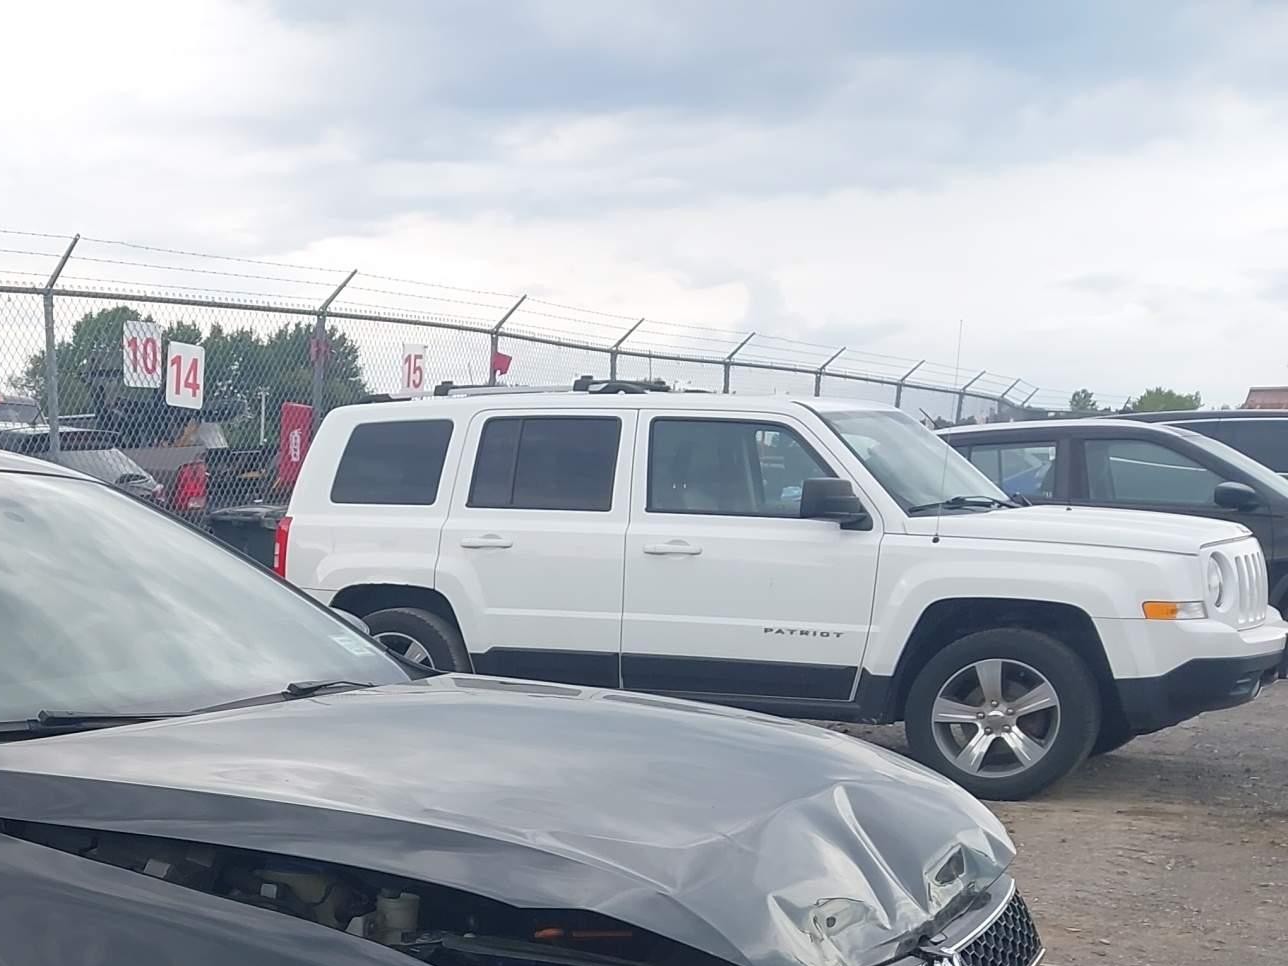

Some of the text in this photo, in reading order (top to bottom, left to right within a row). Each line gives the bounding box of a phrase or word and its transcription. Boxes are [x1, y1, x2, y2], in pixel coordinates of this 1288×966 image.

[127, 336, 158, 375] 10
[404, 354, 424, 389] 15
[170, 354, 201, 398] 14
[763, 627, 845, 638] PATRIOT
